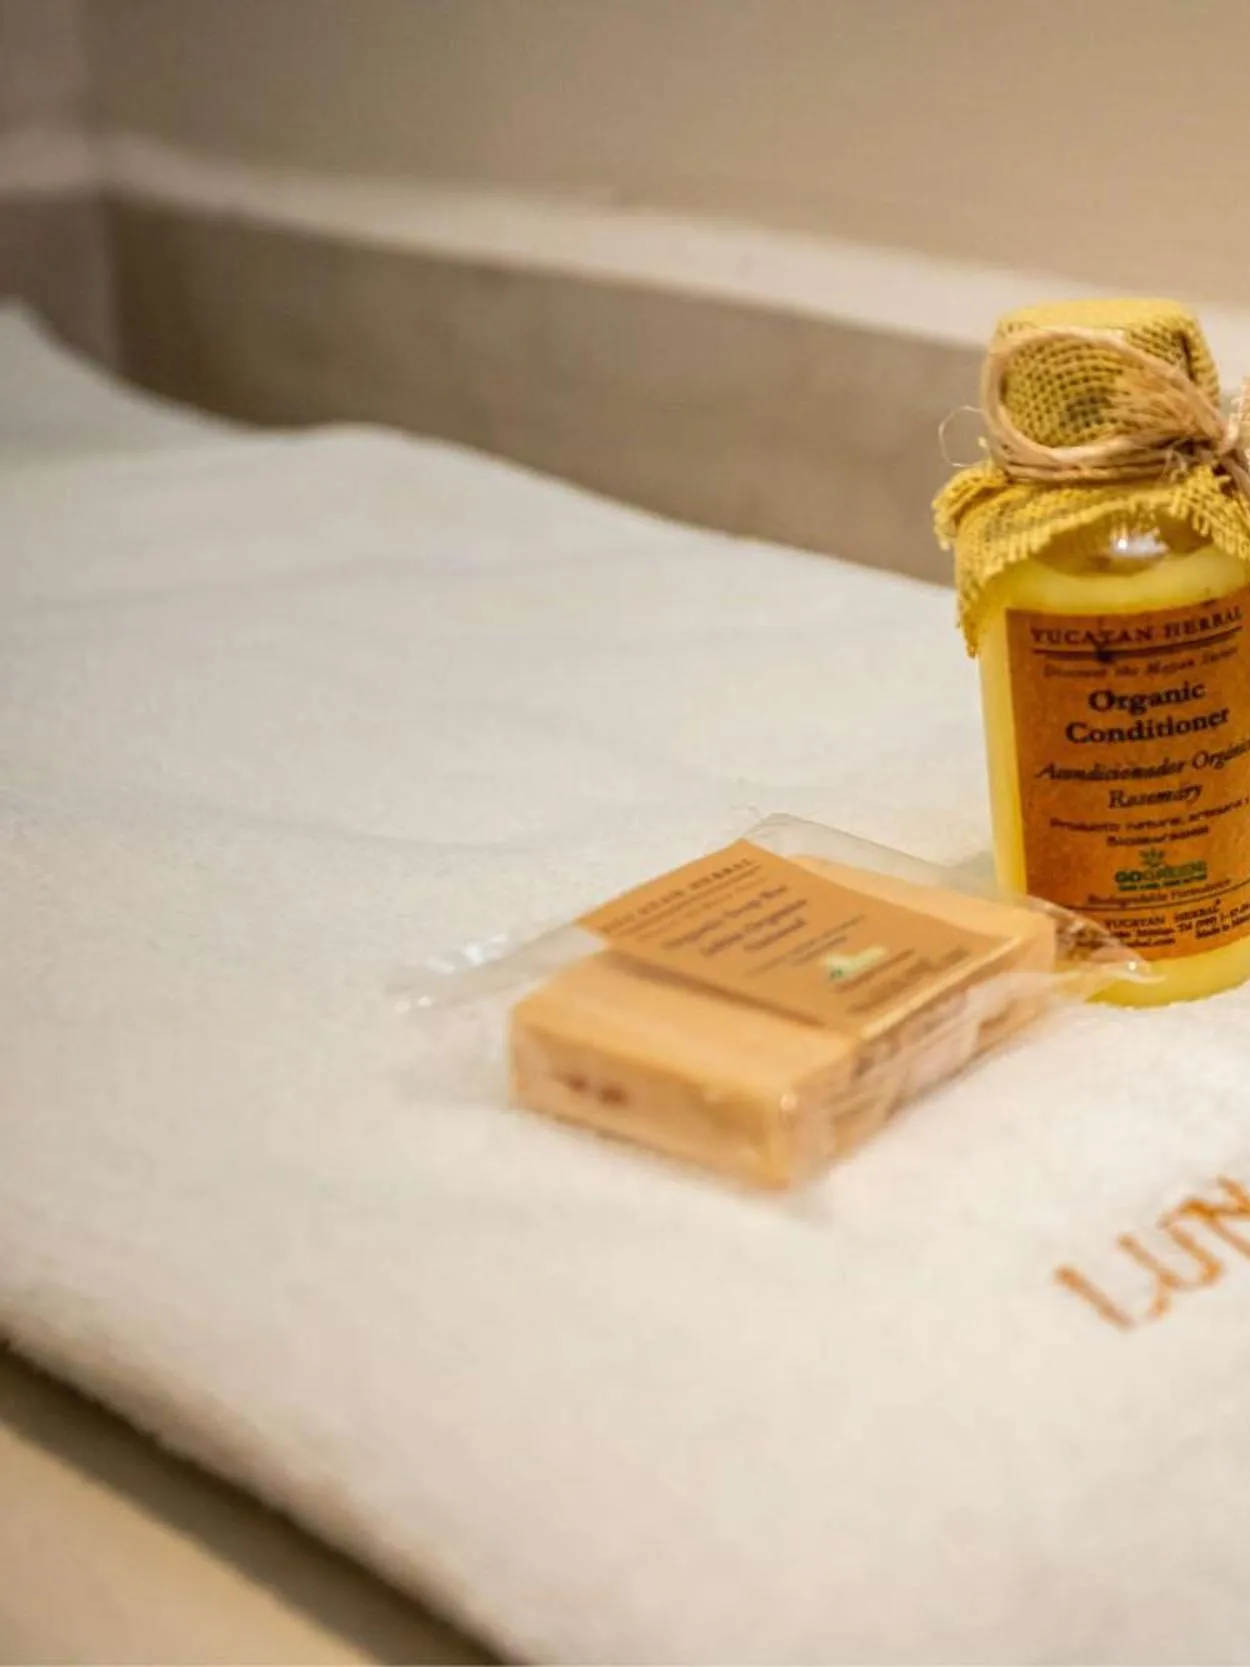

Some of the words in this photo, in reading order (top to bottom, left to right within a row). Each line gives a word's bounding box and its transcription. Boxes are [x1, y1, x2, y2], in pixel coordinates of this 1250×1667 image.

[1164, 605, 1243, 639] HERBAL
[1088, 680, 1206, 716] Organic
[1065, 706, 1231, 745] Conditioner
